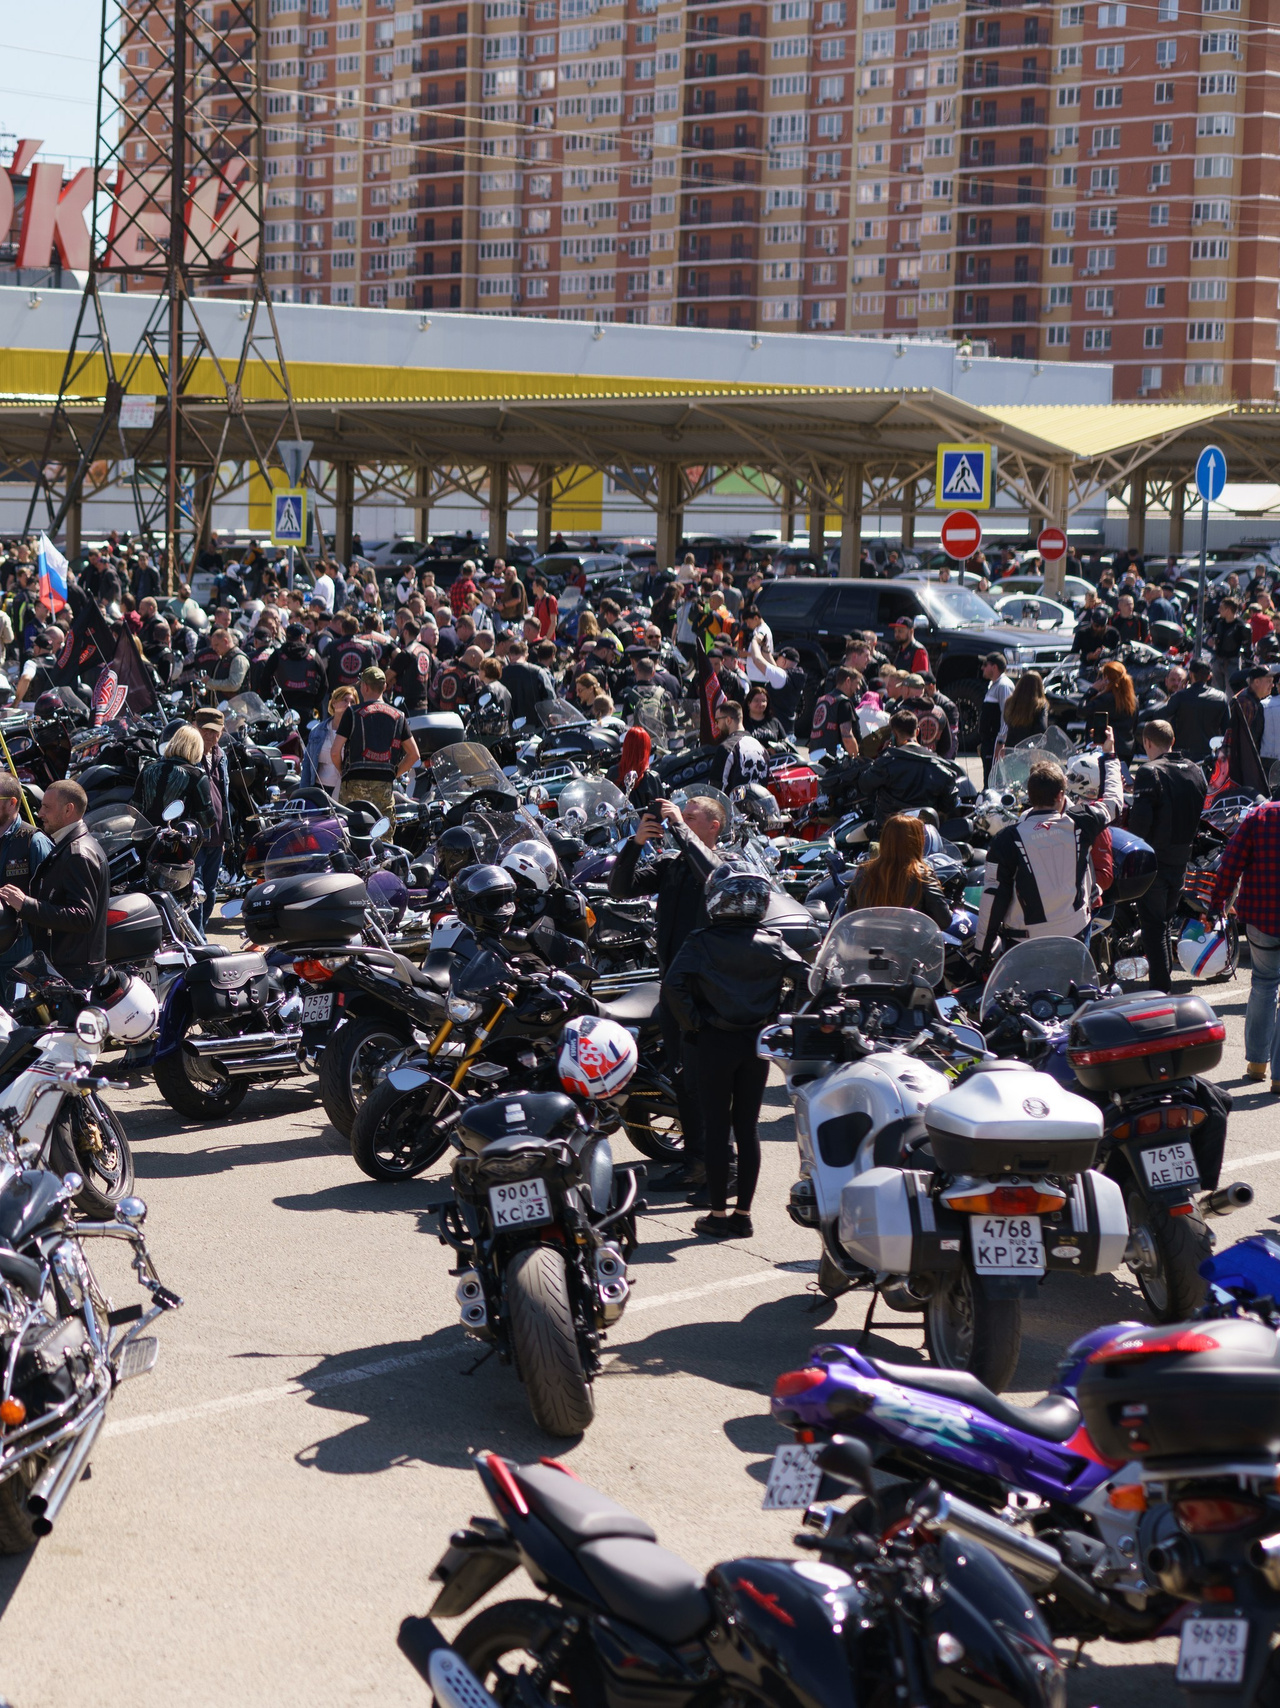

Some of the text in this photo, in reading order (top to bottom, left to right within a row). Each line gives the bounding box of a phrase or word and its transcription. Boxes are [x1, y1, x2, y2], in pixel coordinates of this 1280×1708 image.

[307, 995, 329, 1007] 7579
[304, 1009, 329, 1020] PC 61
[580, 1043, 601, 1066] 93
[1148, 1146, 1185, 1164] 7615
[1151, 1165, 1195, 1185] AE 70
[498, 1182, 539, 1202] 9001
[497, 1203, 545, 1224] KC 23
[983, 1221, 1031, 1238] 4768
[978, 1247, 1007, 1264] KP
[1017, 1246, 1038, 1264] 23
[1193, 1624, 1238, 1644] 9698
[1183, 1657, 1238, 1677] KT 23
